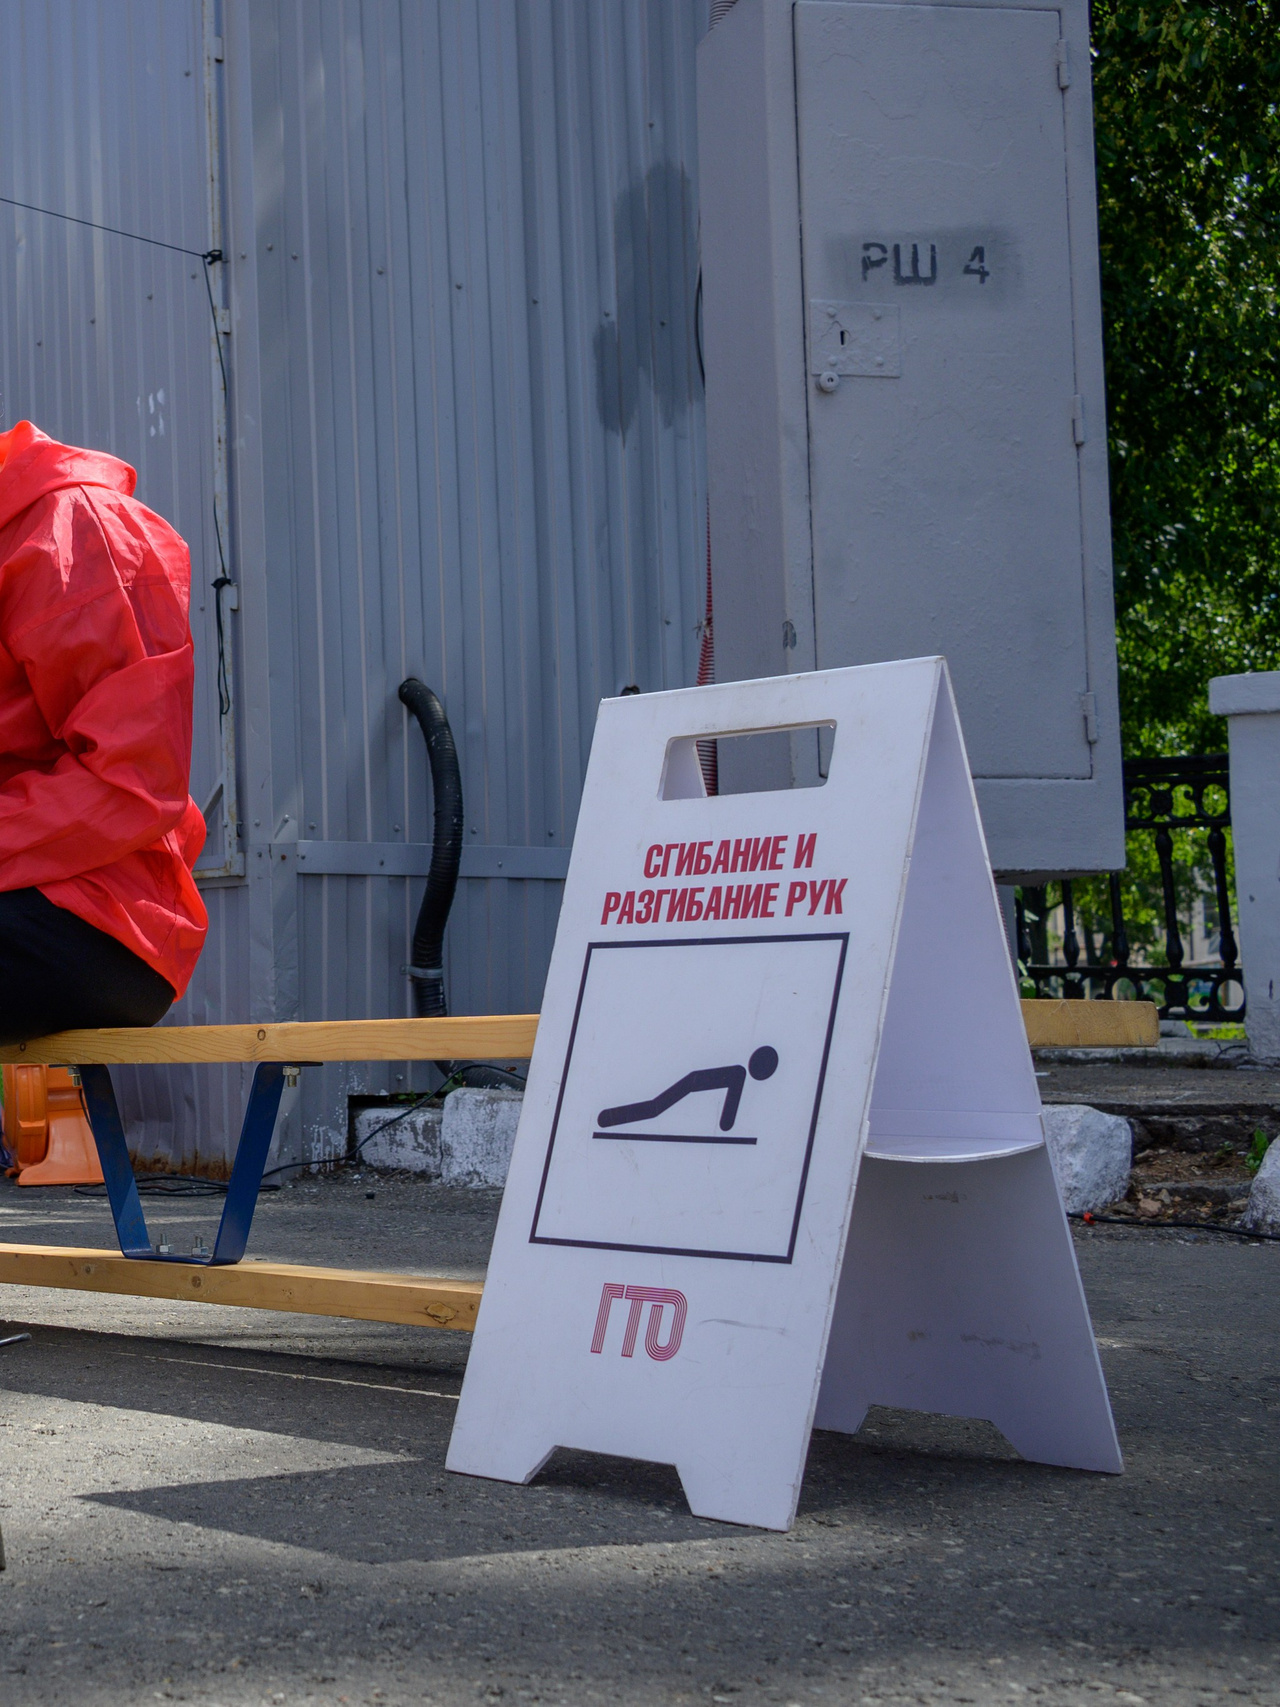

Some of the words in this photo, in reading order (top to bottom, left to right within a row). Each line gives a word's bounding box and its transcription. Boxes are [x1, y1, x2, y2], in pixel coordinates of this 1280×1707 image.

[862, 242, 937, 286] РШ
[963, 246, 990, 285] 4
[643, 835, 788, 879] СГИБАНИЕ
[793, 832, 817, 869] И
[600, 882, 780, 926] РАЗГИБАНИЕ
[784, 878, 849, 917] РУК
[590, 1282, 688, 1362] ГТО
